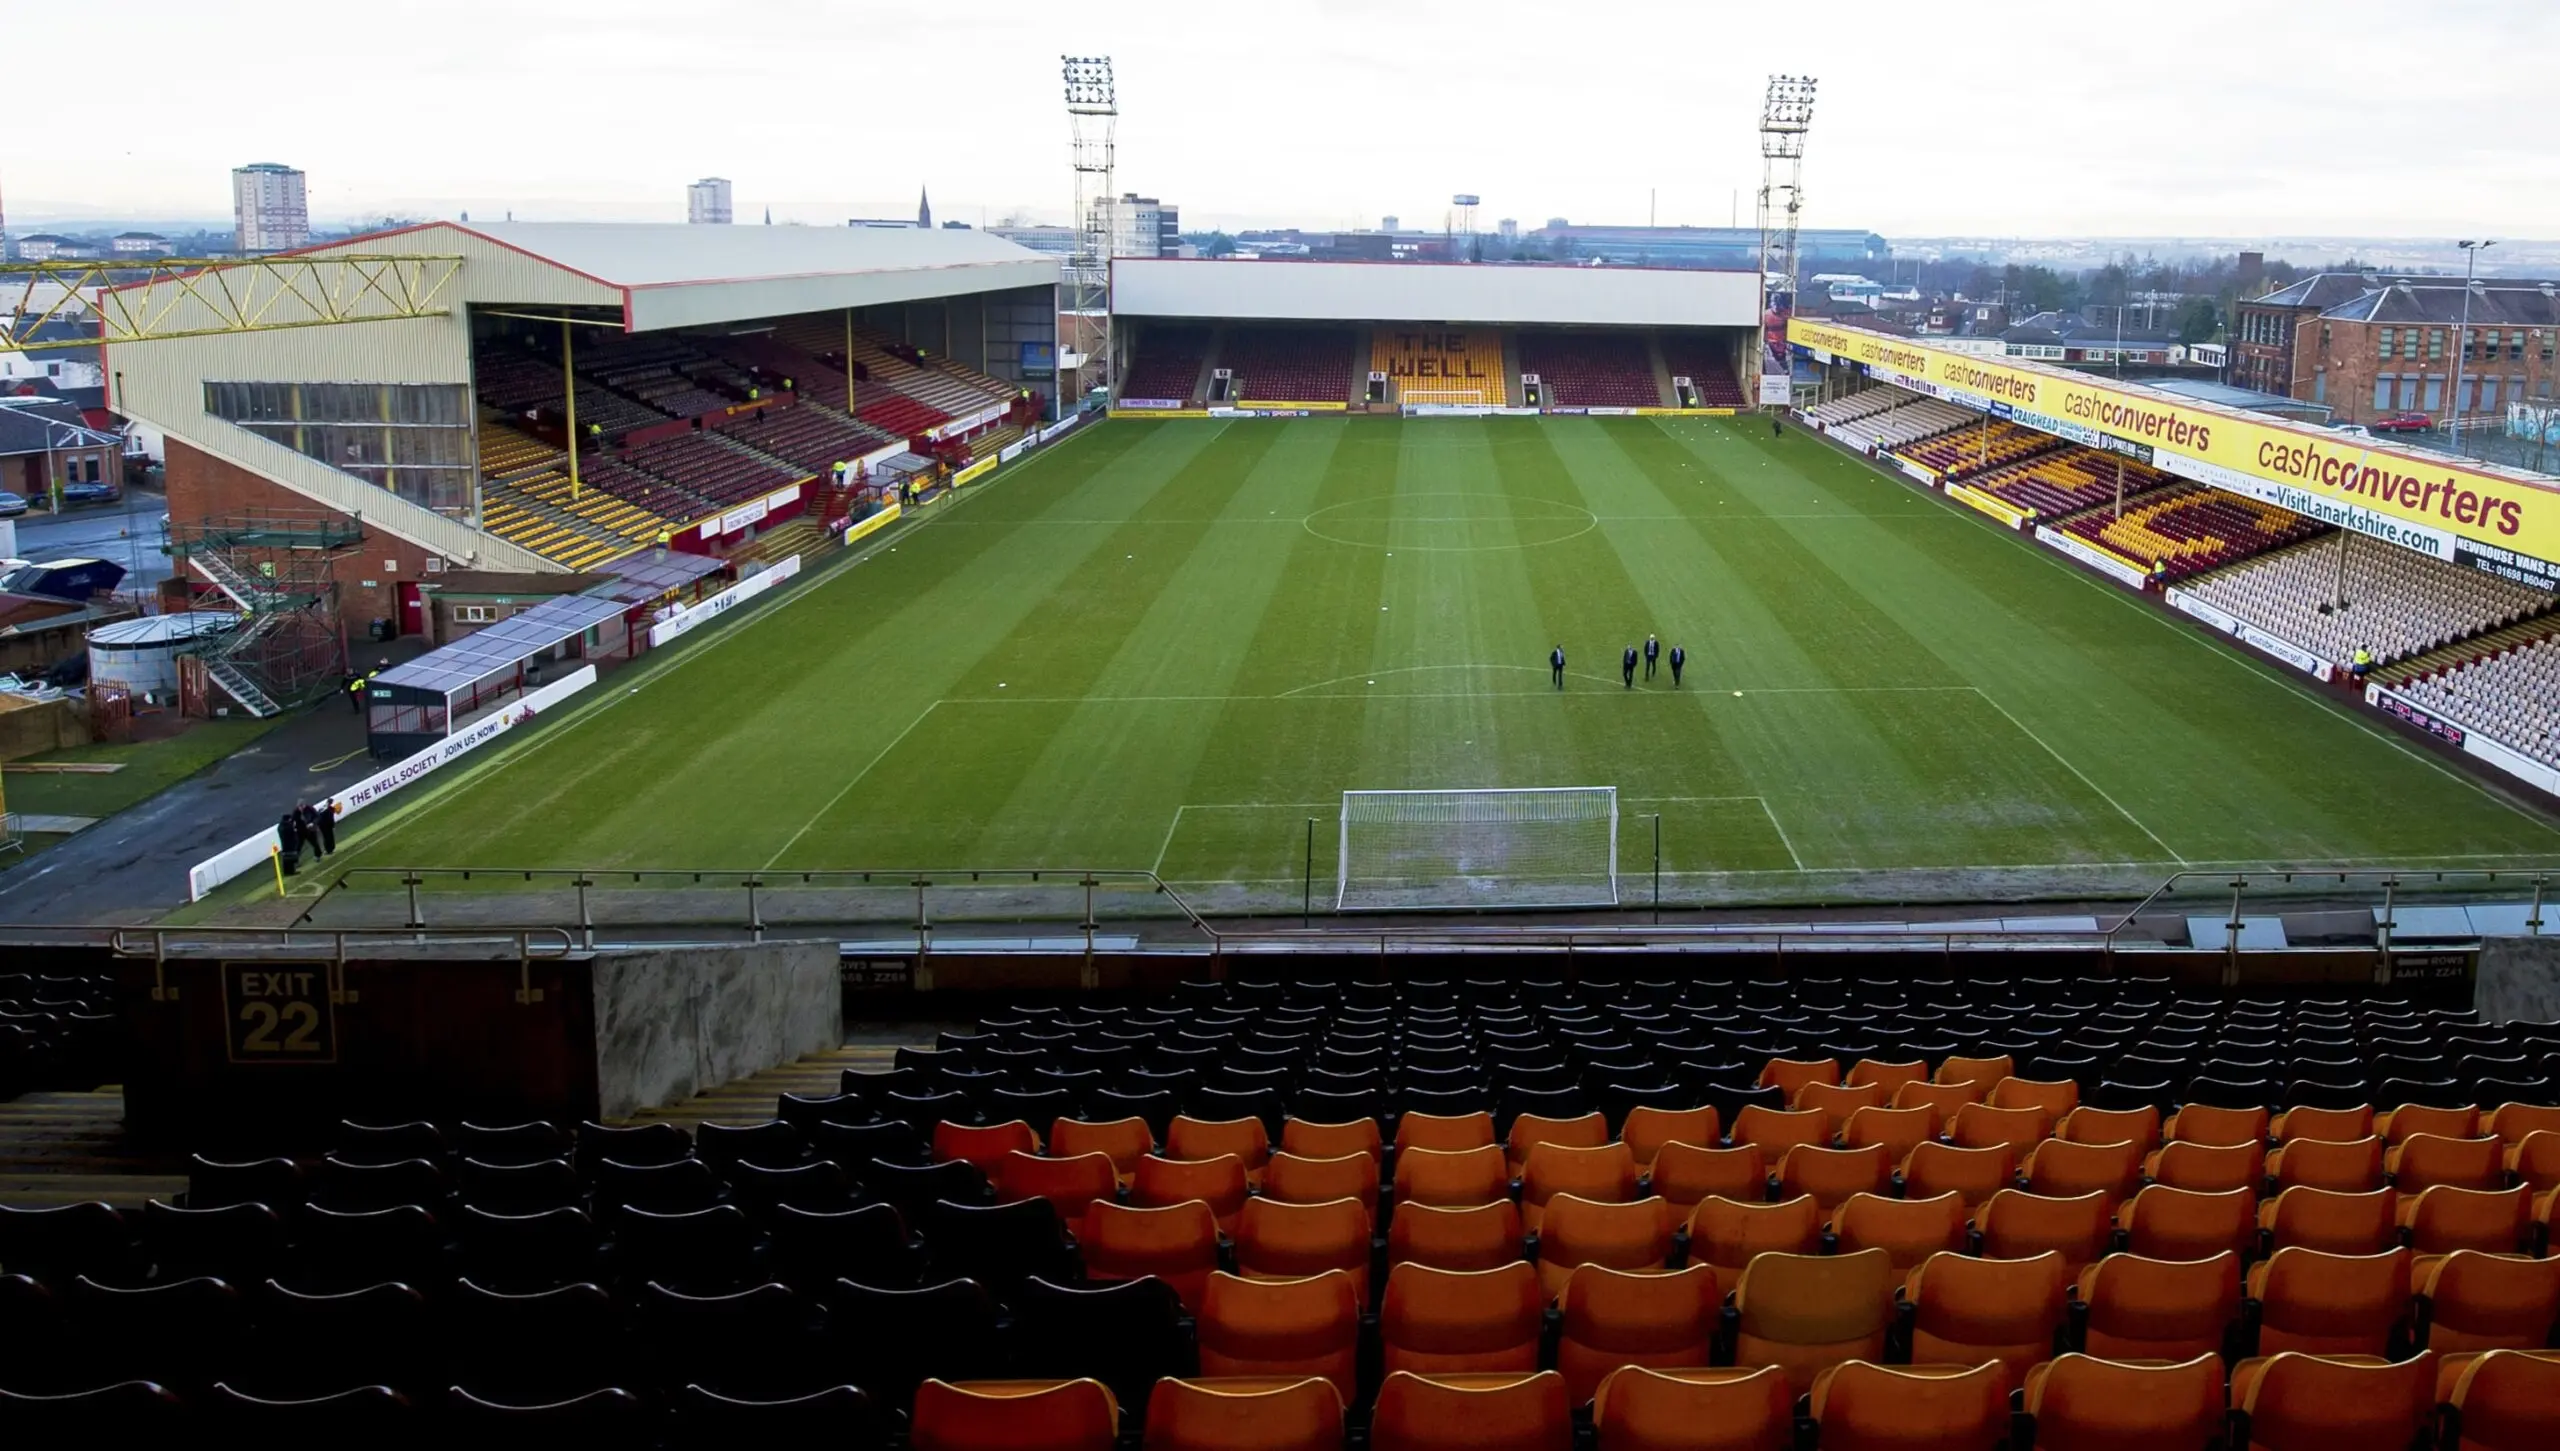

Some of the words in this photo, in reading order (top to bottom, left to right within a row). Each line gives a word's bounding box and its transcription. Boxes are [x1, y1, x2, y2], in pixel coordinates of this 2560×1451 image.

[1395, 333, 1466, 351] THE
[1800, 327, 1848, 352] cashconverters
[1388, 358, 1486, 377] WELL
[1861, 341, 1926, 373] cashconverters
[1904, 375, 1938, 395] Redline
[1944, 361, 2036, 403] cashconverters
[2013, 407, 2059, 432] CRAIGHEAD
[2064, 391, 2211, 452] cashconverters
[2258, 440, 2523, 536] cashconverters
[2277, 485, 2440, 555] VisitLanarkshire.com
[2456, 537, 2515, 565] NEWHOUSE
[2515, 554, 2546, 574] VANS
[2476, 558, 2496, 573] TEL:
[350, 788, 372, 806] THE
[372, 774, 400, 796] WELL
[399, 753, 439, 782] SOCIETY
[444, 740, 464, 759] JOIN
[464, 732, 476, 747] US
[477, 721, 499, 738] NOW!
[2430, 956, 2465, 965] ROWS
[240, 972, 315, 996] EXIT
[240, 1001, 321, 1051] 22
